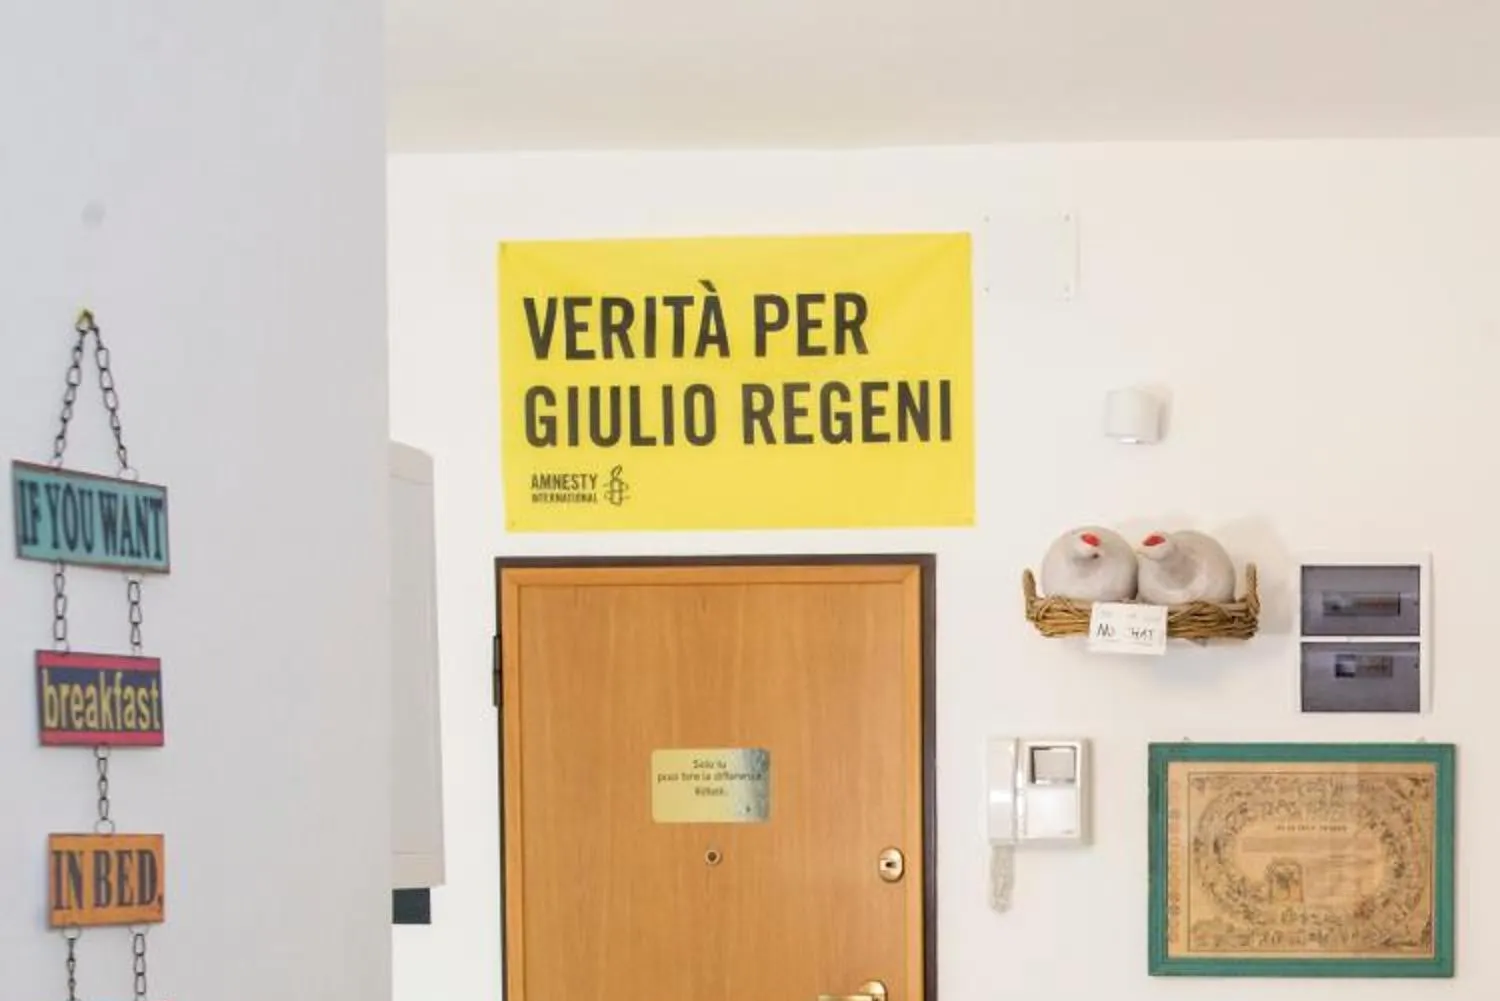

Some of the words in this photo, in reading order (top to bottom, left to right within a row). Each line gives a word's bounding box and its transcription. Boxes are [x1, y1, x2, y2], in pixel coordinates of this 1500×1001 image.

[523, 279, 731, 361] VERITÀ
[753, 292, 870, 358] PER
[524, 383, 718, 448] GIULIO
[740, 379, 952, 446] REGENI
[531, 473, 598, 491] AMNESTY
[18, 479, 43, 546] IF
[45, 482, 95, 554] YOU
[98, 489, 163, 561] WANT
[41, 666, 161, 731] breakfast
[52, 850, 84, 911] IN
